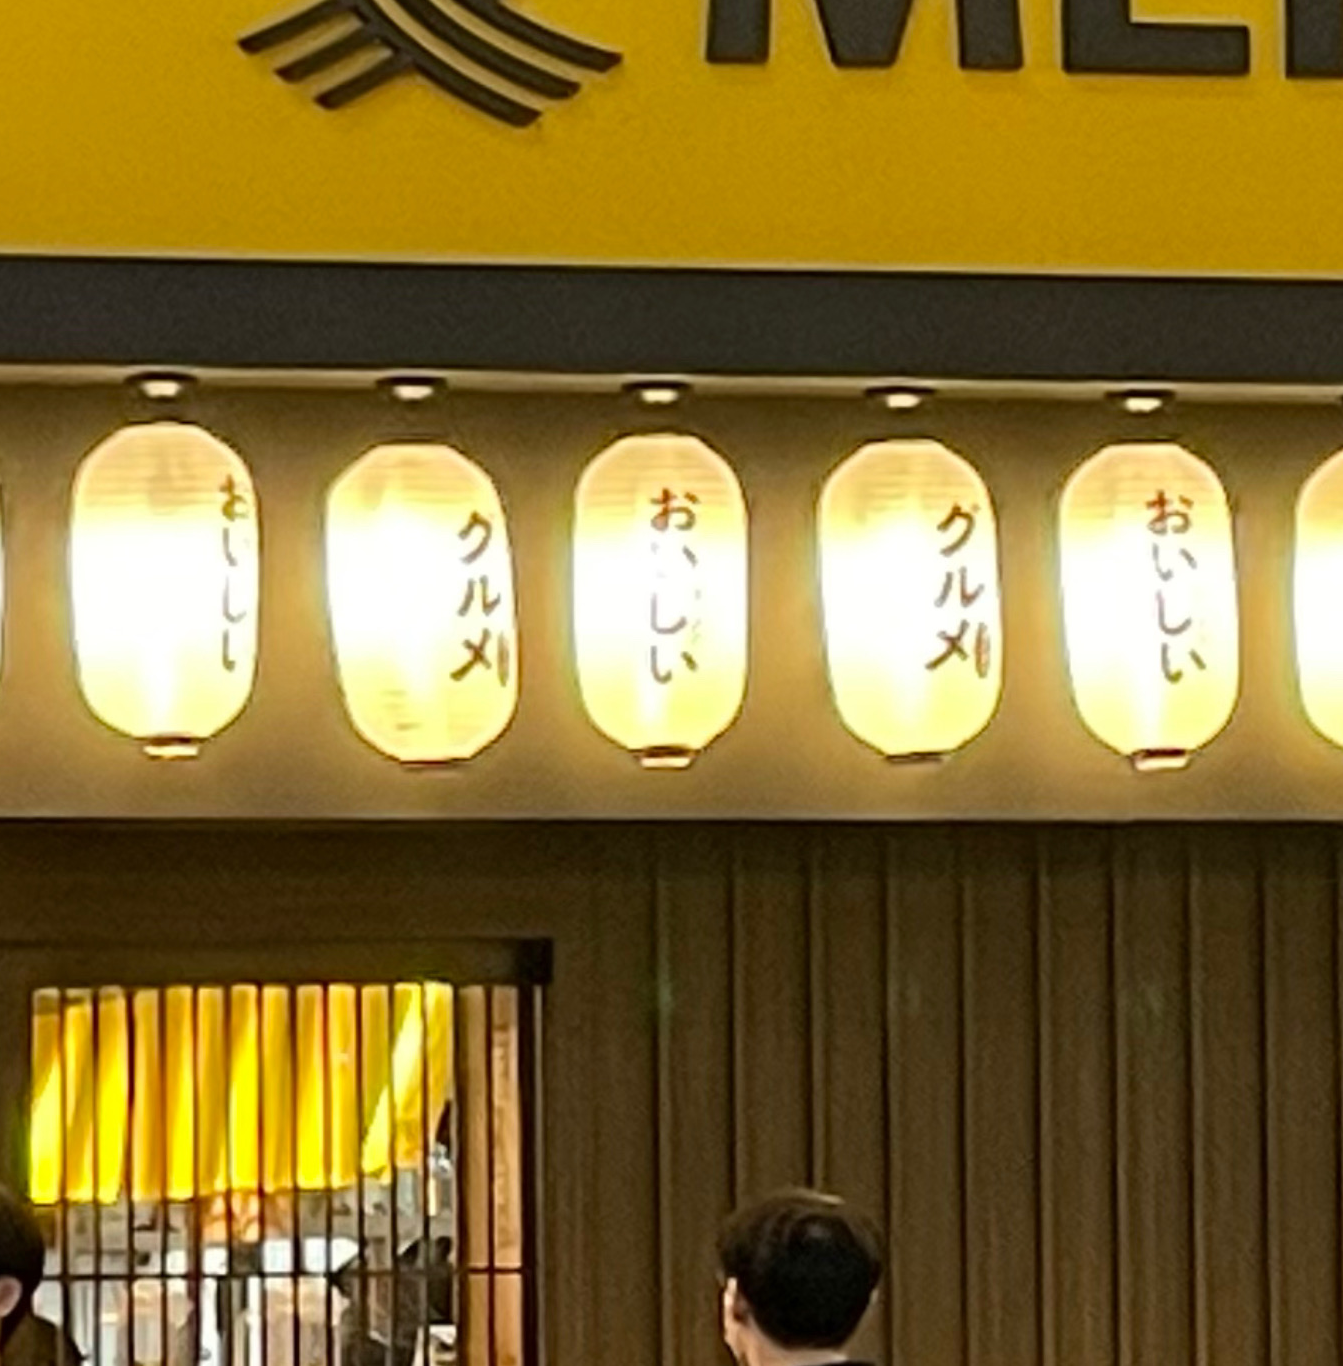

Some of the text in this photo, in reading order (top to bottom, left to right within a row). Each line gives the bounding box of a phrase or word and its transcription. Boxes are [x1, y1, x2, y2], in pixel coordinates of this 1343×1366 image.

[925, 502, 984, 672] グルメ
[1146, 489, 1206, 685] おいしい
